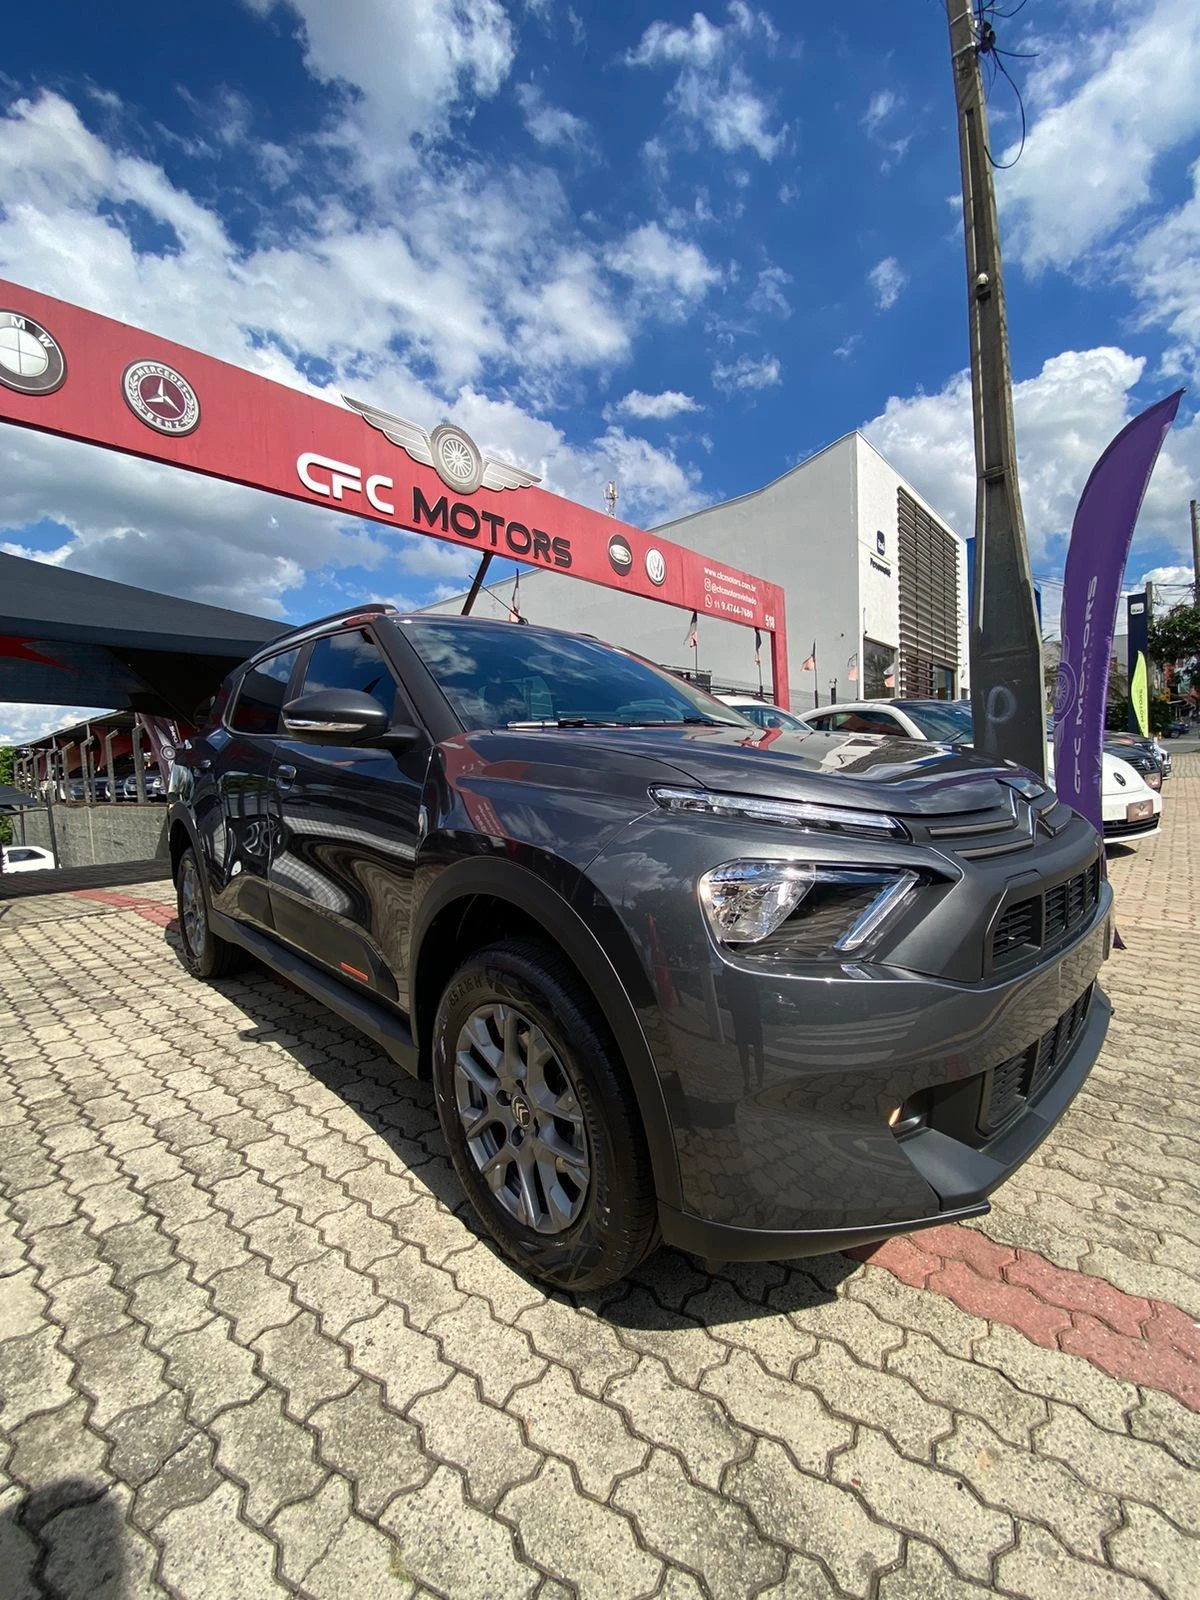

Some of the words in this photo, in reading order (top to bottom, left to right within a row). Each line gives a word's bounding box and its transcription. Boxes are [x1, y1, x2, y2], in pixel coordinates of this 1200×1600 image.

[135, 366, 188, 393] MERCEDES
[147, 412, 181, 429] BENZ
[296, 452, 395, 515] CFC
[412, 486, 573, 568] MOTORS
[1075, 575, 1098, 725] MOTORS
